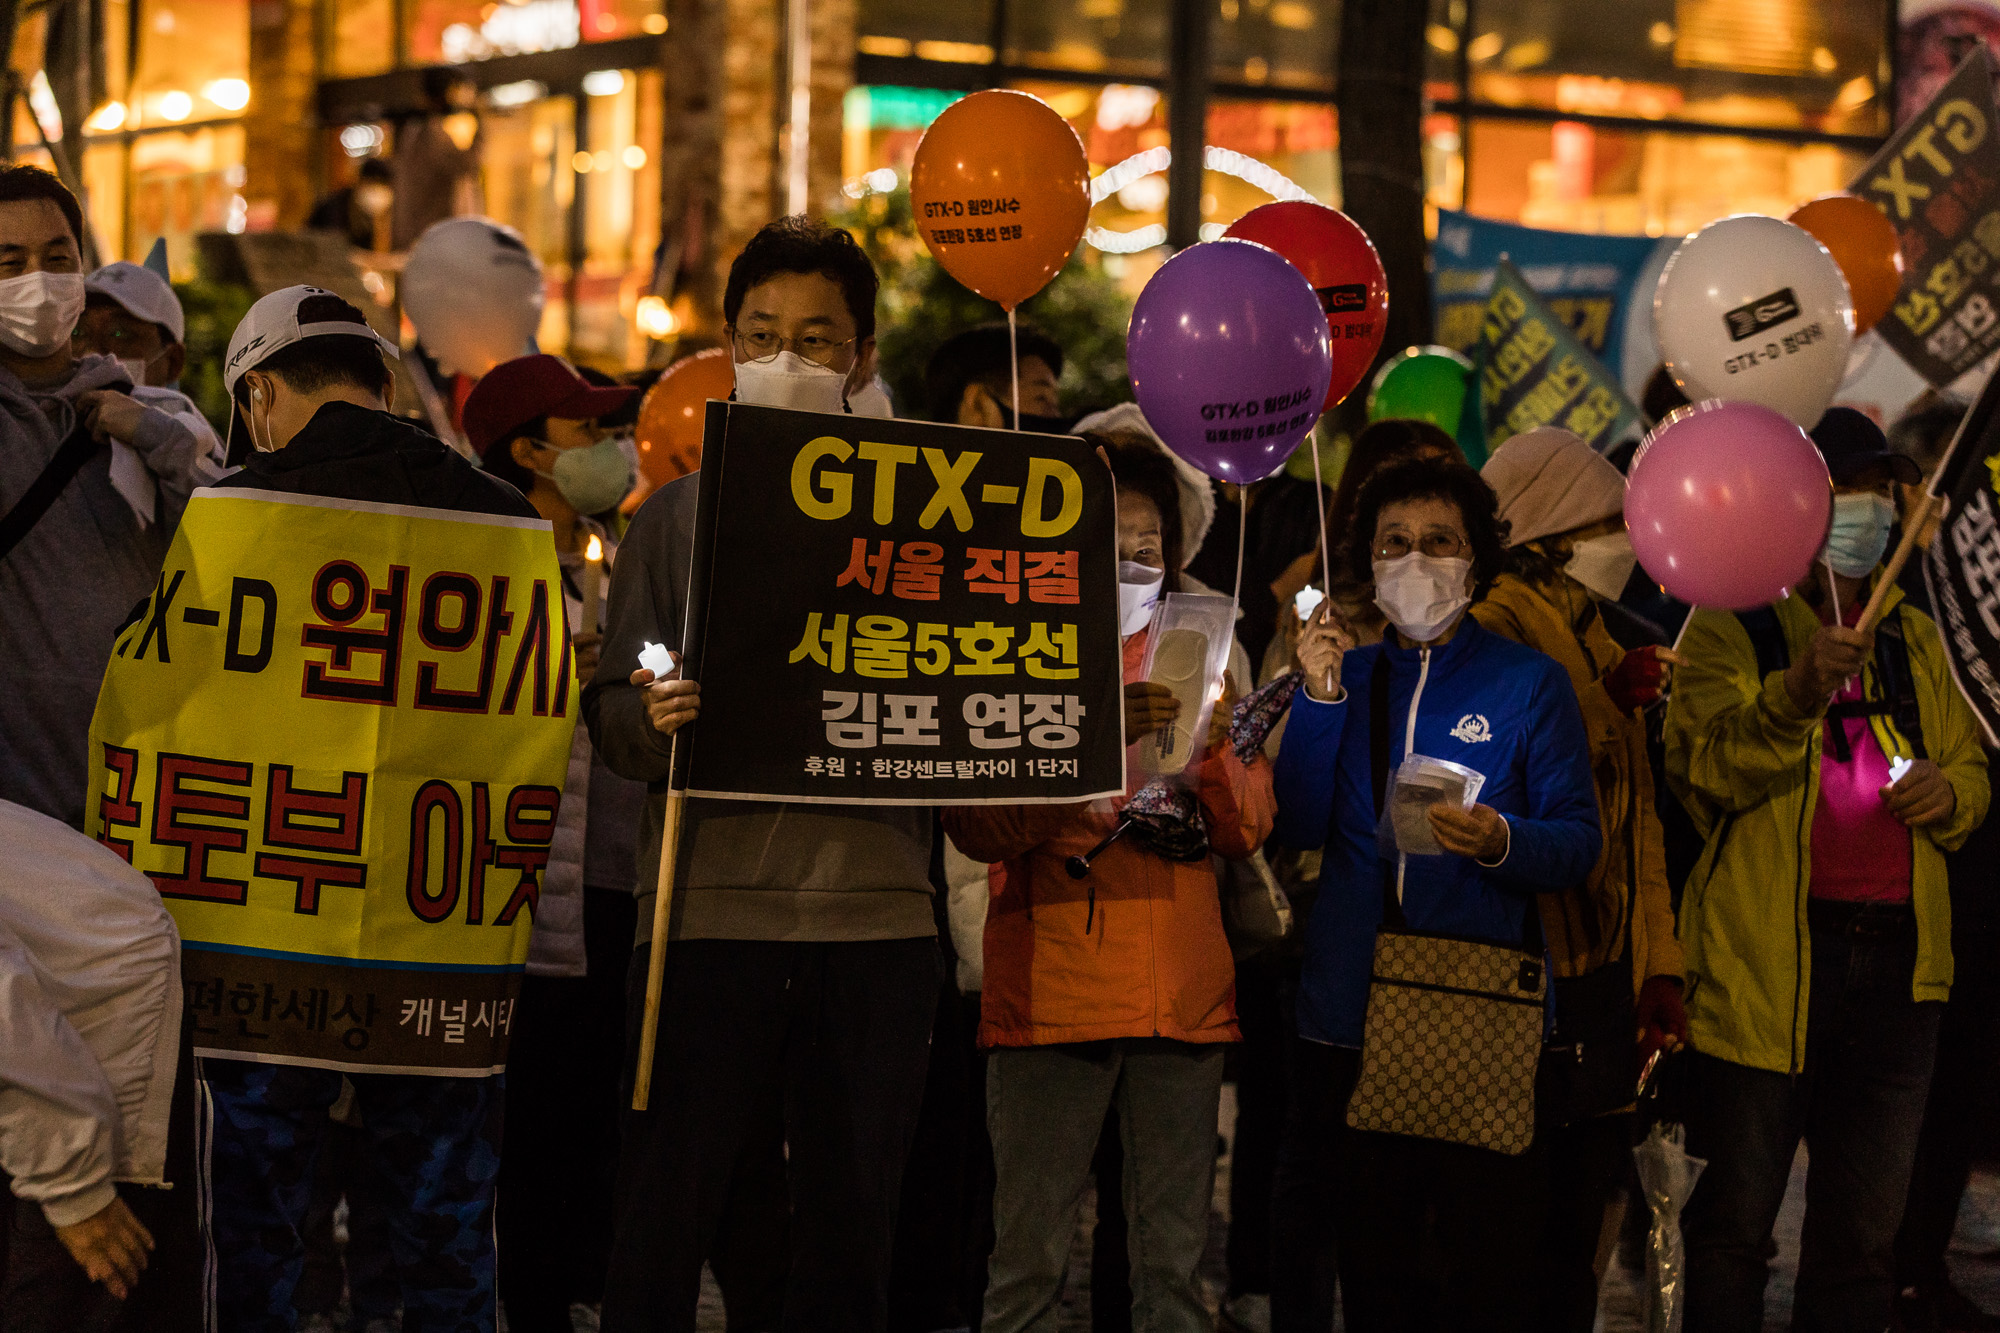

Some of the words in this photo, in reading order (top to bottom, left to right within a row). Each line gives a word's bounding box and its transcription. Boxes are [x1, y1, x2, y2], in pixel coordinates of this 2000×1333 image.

[924, 200, 964, 218] GTX-D
[967, 197, 1021, 216] 원안사수
[967, 226, 997, 243] 5호선
[999, 224, 1023, 241] 연장
[1724, 343, 1781, 374] GTX-D
[1201, 401, 1260, 421] GTX-D
[1264, 386, 1312, 414] 원안사수
[790, 436, 1084, 538] GTX-D
[836, 537, 944, 600] 서울
[964, 547, 1080, 604] 직결
[789, 612, 1080, 679] 서울5호선
[822, 690, 941, 749] 김포
[962, 692, 1086, 749] 연장
[804, 756, 846, 778] 후원
[872, 758, 1016, 779] 한강센트럴자이
[1025, 758, 1079, 778] 1단지
